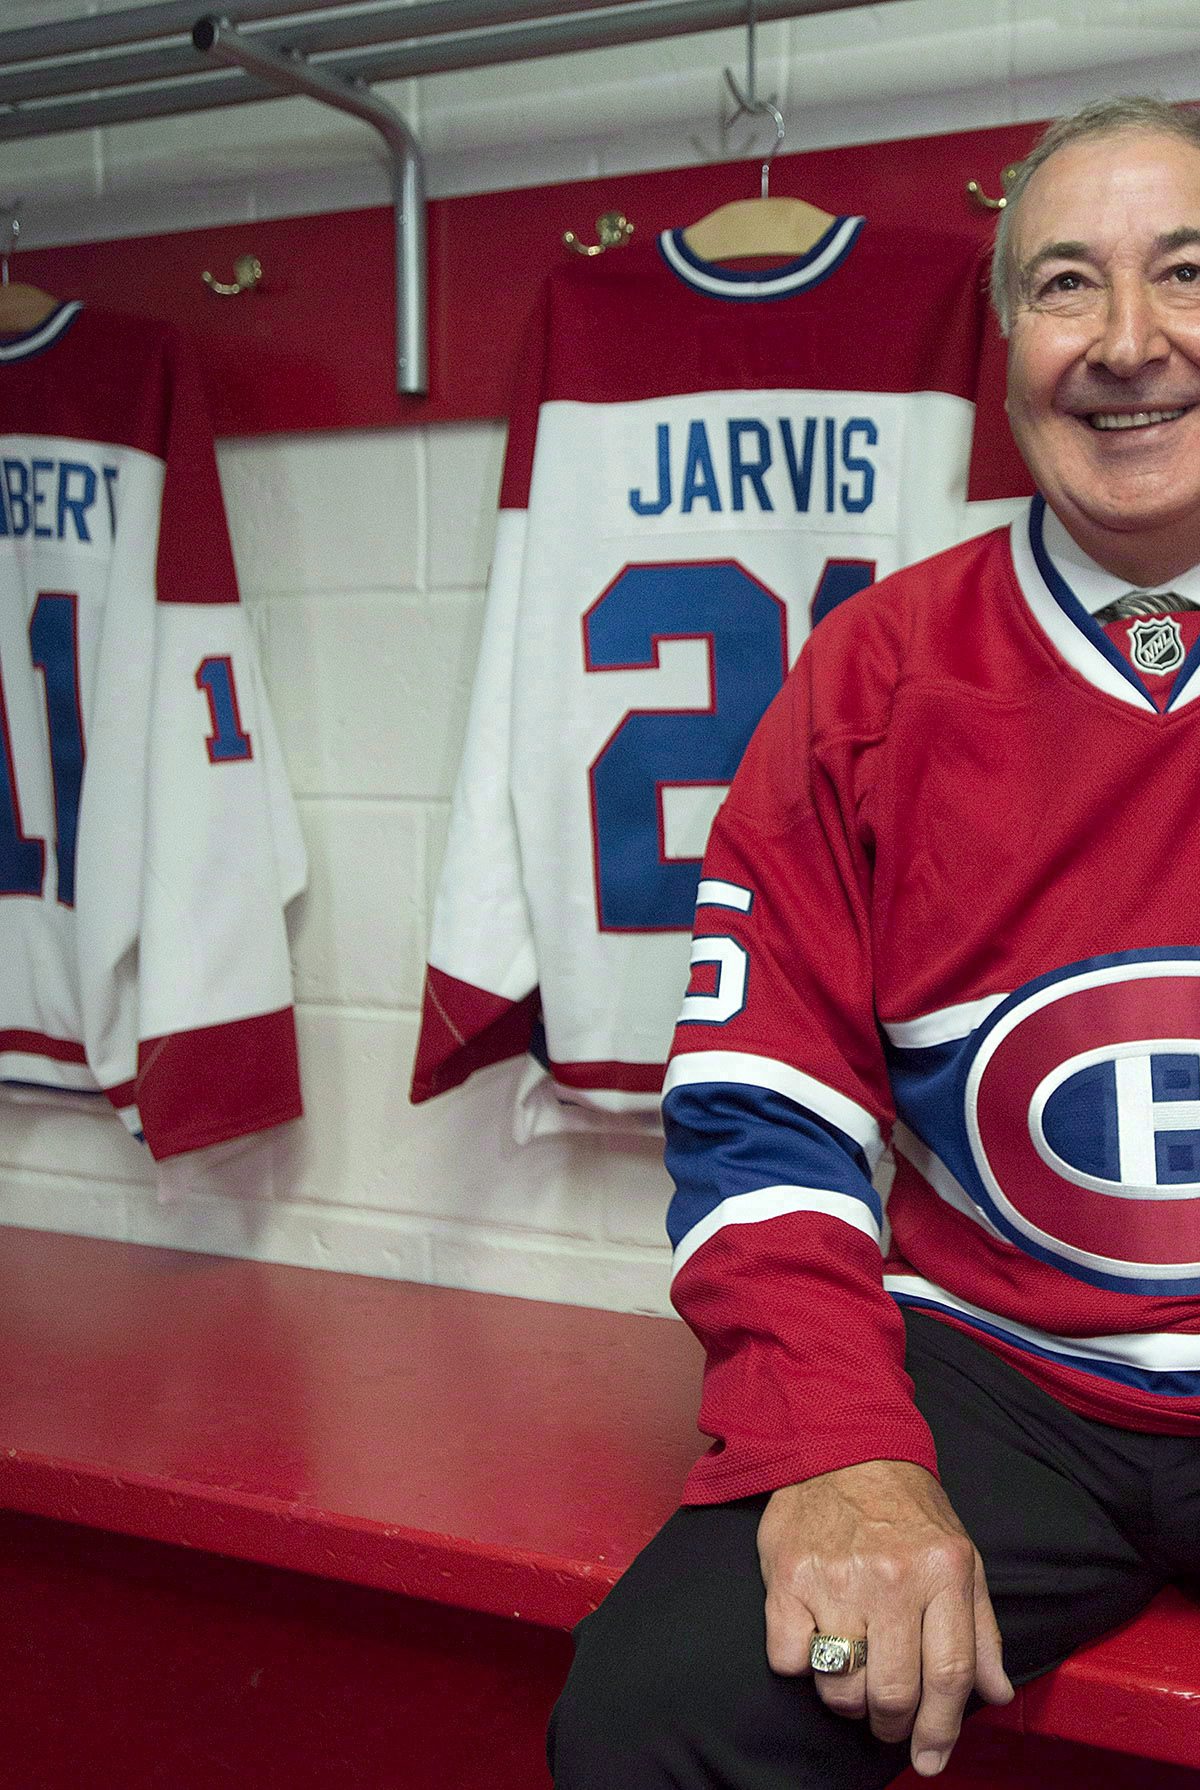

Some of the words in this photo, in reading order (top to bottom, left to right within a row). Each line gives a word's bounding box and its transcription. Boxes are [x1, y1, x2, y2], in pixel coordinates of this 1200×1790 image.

[0, 459, 119, 544] BERT
[628, 416, 879, 517] JARVIS
[1142, 632, 1172, 664] NHL
[195, 654, 254, 764] 1
[581, 557, 878, 934] 2
